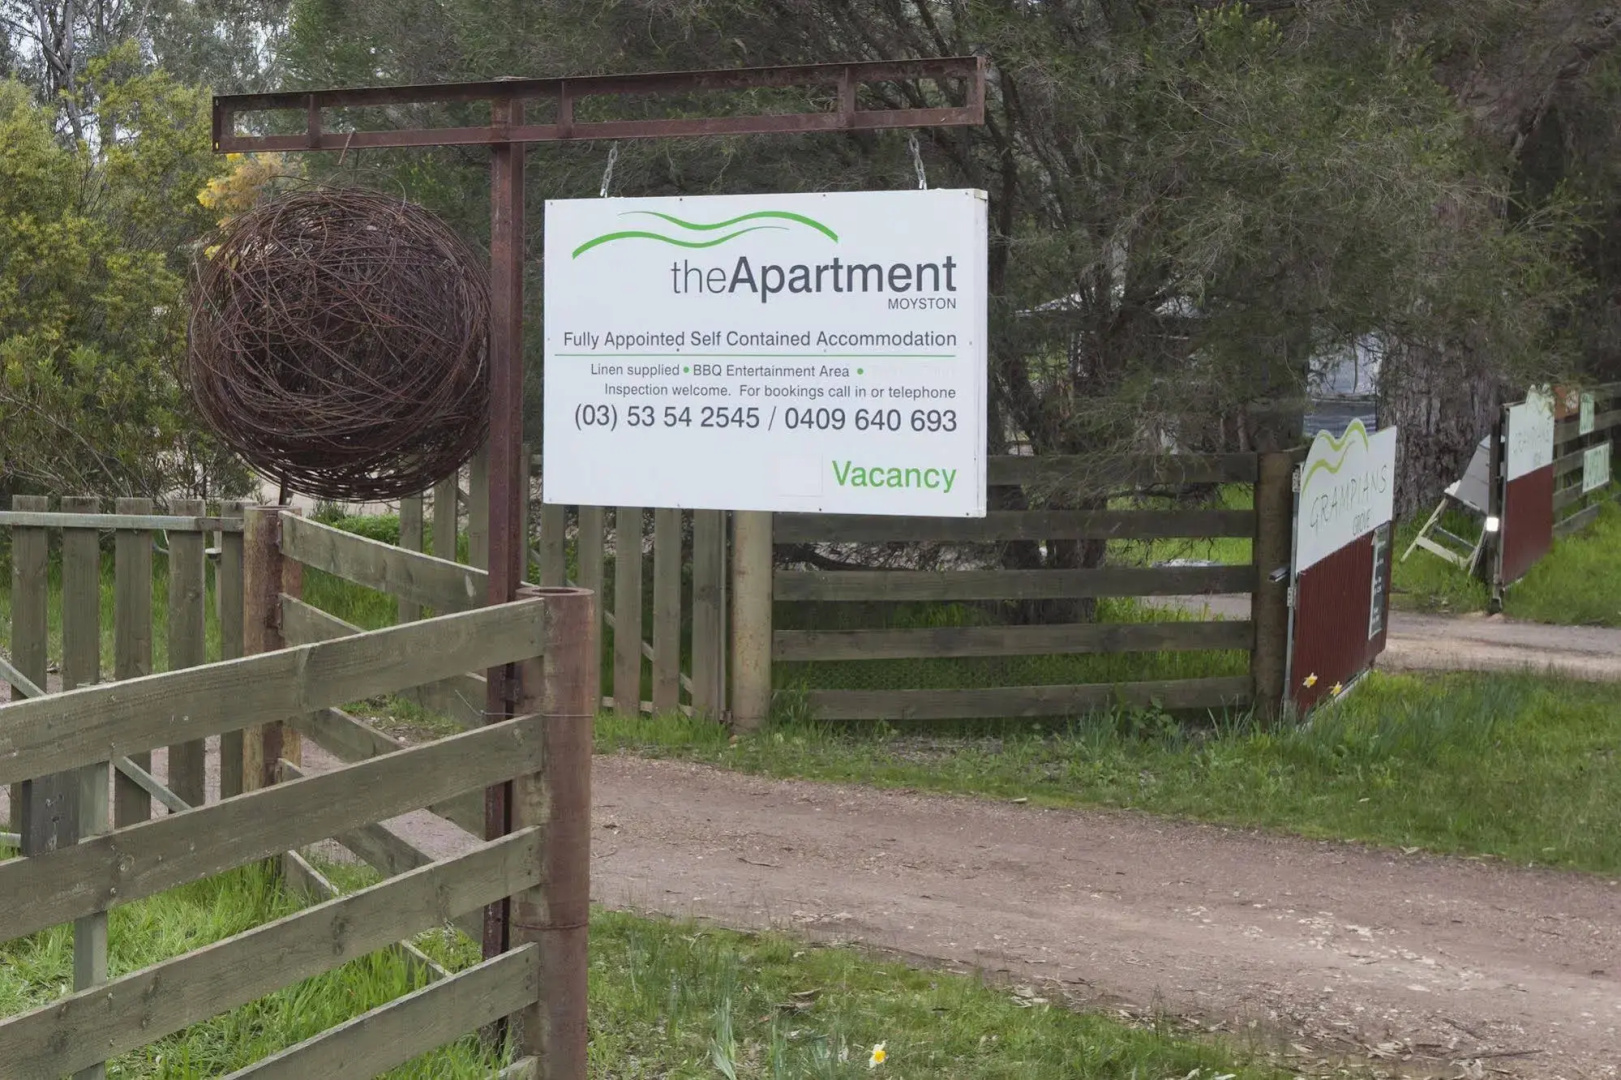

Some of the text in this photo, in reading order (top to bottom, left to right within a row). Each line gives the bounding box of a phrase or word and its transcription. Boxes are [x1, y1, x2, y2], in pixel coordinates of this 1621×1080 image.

[670, 255, 957, 304] theApartment
[887, 297, 957, 310] MOYSTON
[563, 330, 957, 348] Fully Appointed Self Contained Accommodation
[590, 363, 850, 380] Linen supplied BBQ Entertainment Area
[604, 383, 957, 401] Inspection welcome. For bookings call in or telephone
[574, 403, 958, 433] (03) 53 54 2545 / 0409 640 693
[831, 460, 957, 494] Vacancy
[1309, 464, 1387, 537] GRAMPIANS
